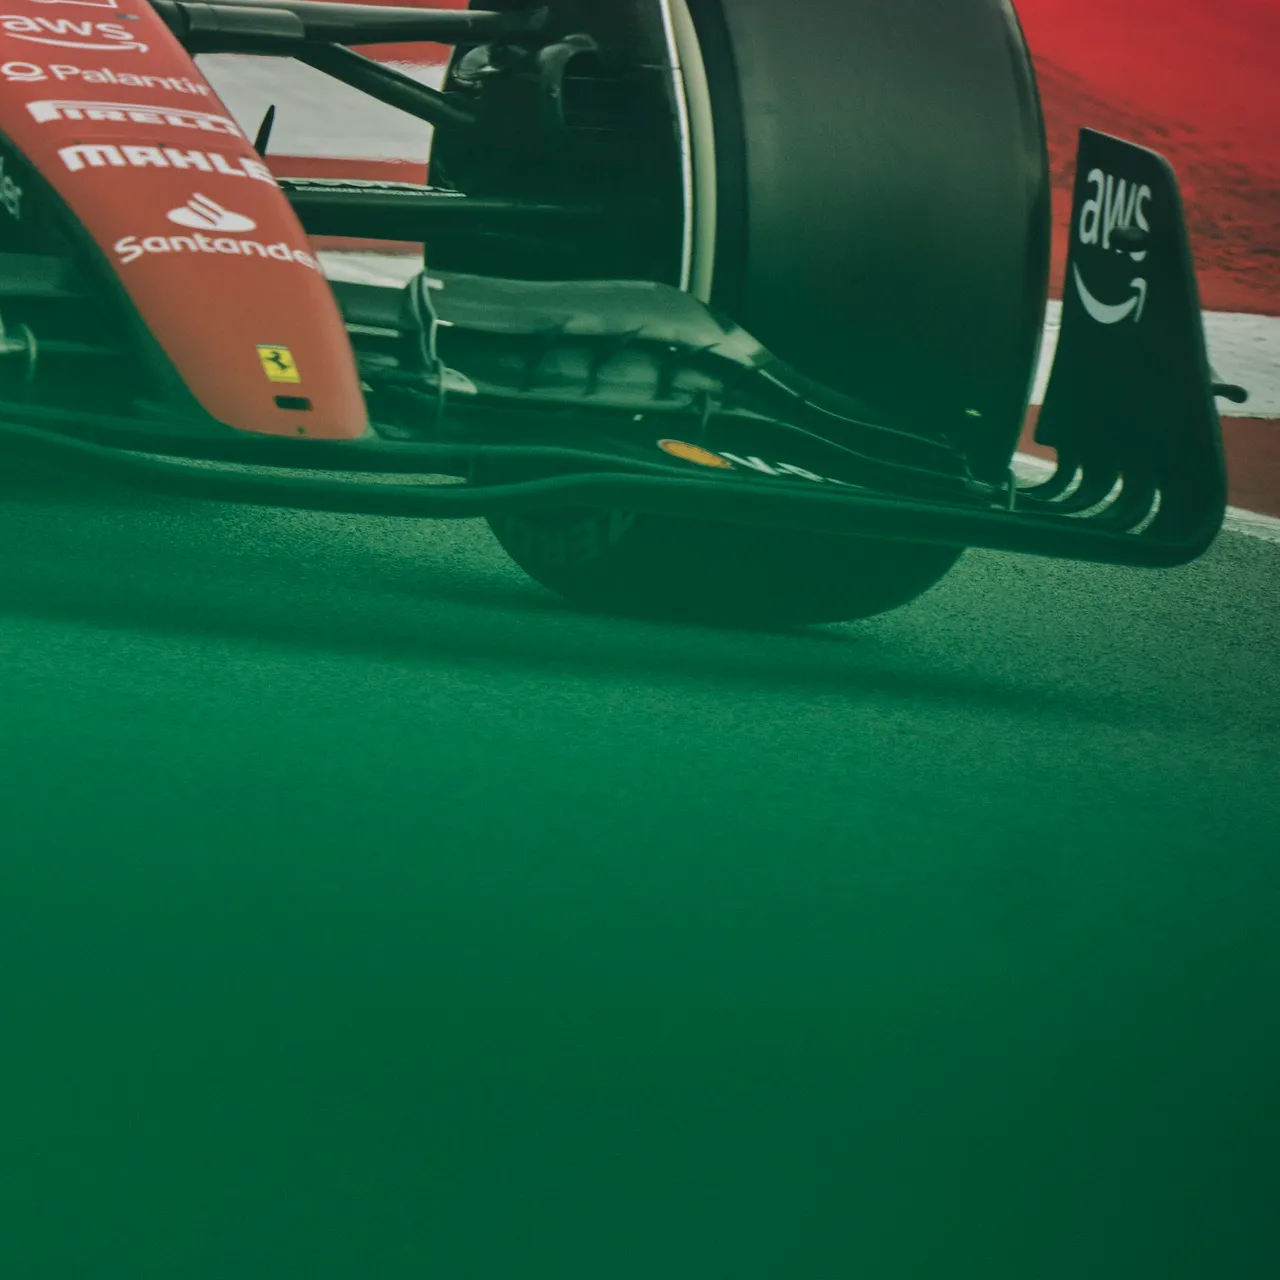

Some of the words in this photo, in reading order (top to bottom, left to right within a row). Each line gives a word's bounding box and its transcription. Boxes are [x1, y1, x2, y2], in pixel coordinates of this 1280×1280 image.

[47, 63, 210, 97] Palantir
[26, 99, 243, 139] PIRELLI
[57, 143, 280, 188] MAHLE
[1079, 168, 1151, 262] aws
[114, 232, 321, 271] Santande
